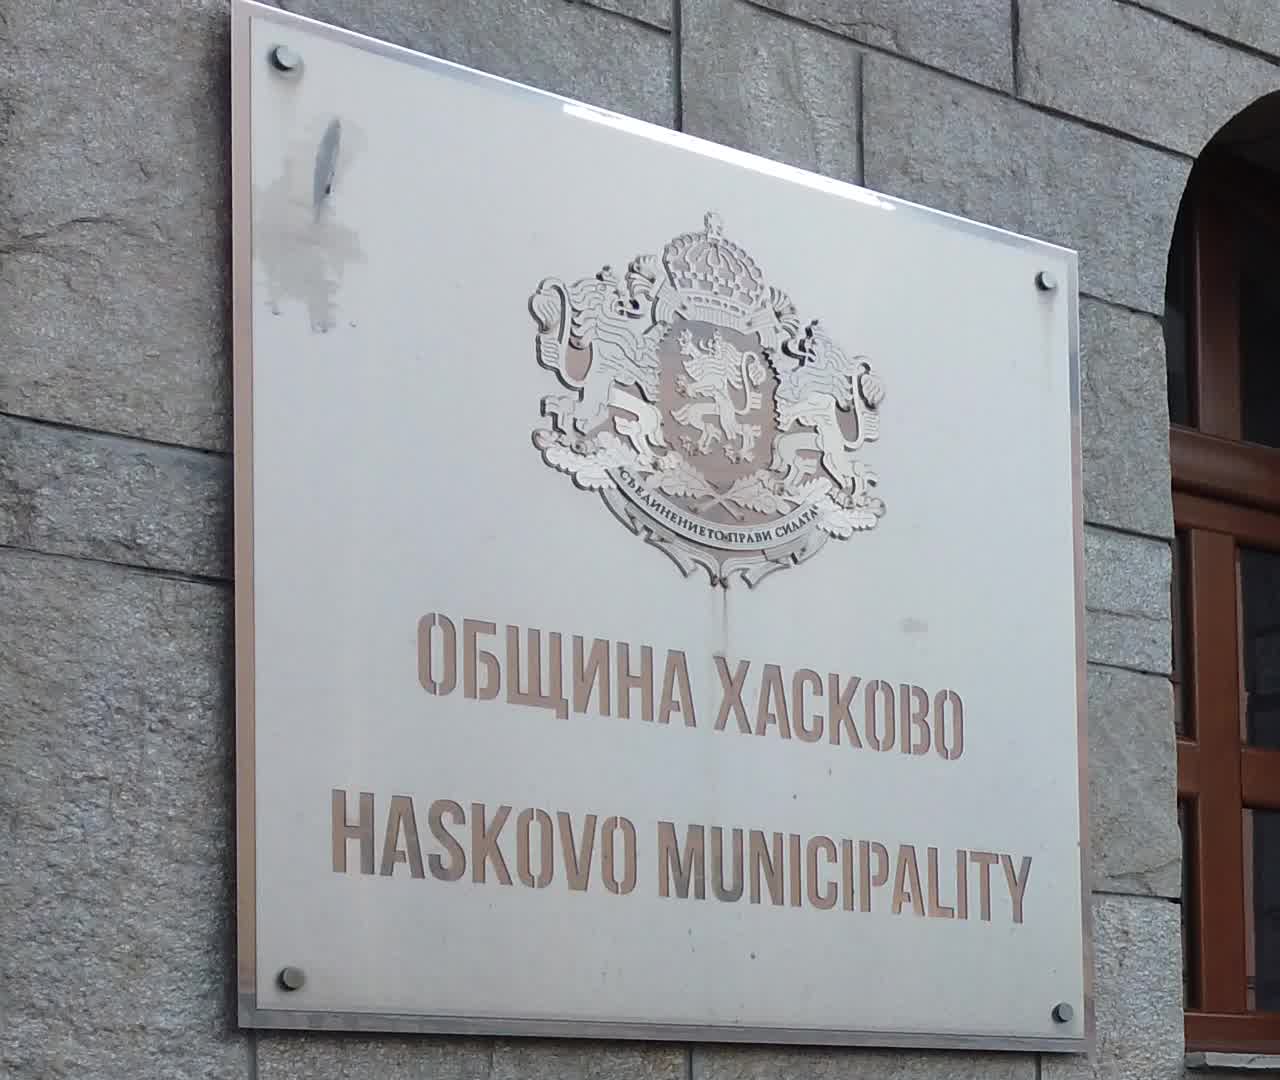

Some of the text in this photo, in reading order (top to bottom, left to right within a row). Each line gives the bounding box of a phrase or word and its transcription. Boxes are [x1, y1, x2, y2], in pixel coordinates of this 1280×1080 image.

[417, 612, 964, 760] ОБЩИНА ХАСКОВО
[331, 789, 1032, 923] HASKOVO MUNICIPALITY
